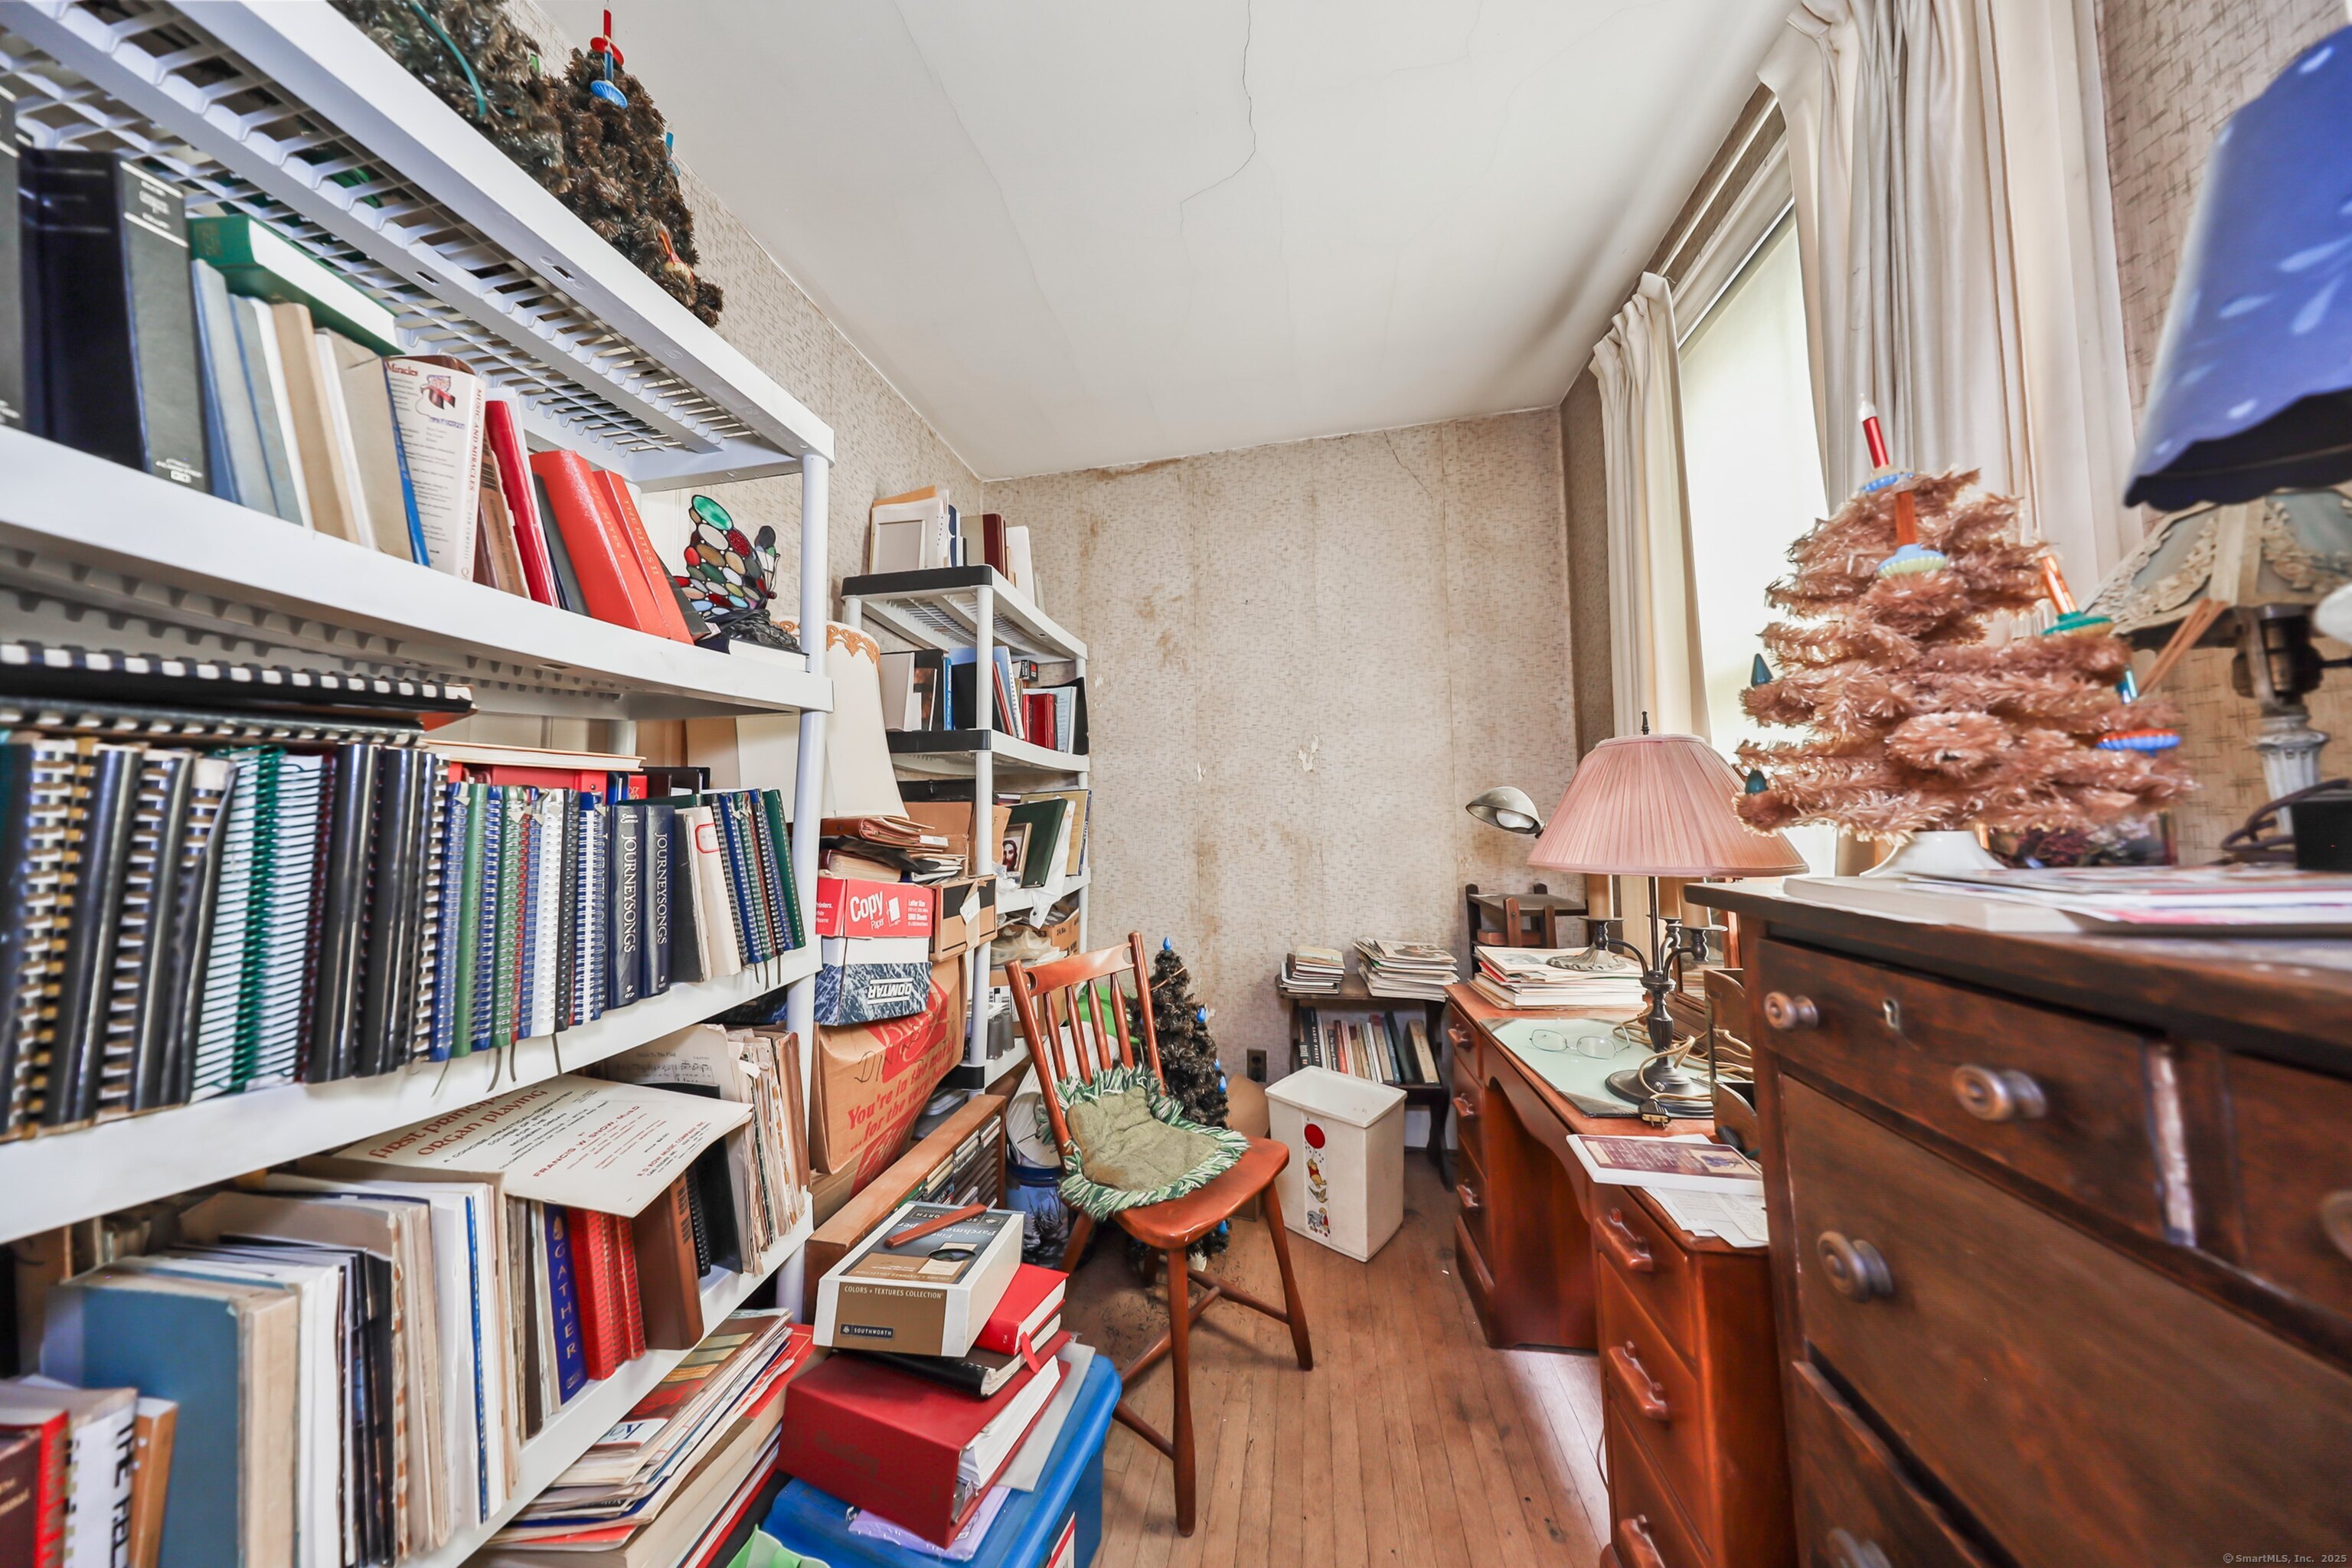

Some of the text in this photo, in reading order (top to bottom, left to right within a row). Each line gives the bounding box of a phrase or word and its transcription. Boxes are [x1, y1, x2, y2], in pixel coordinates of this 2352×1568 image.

[474, 388, 483, 420] MUSIC
[472, 423, 482, 443] AND
[469, 445, 480, 492] MIRACLES
[601, 511, 622, 549] RITES
[622, 498, 637, 524] THE
[634, 527, 655, 564] RITES
[621, 834, 638, 954] JOURNEYSONGS
[655, 832, 668, 946] JOURNEYSONGS
[849, 890, 884, 923] Copy
[871, 917, 884, 931] Paper
[867, 983, 913, 999] DOMTAR
[848, 1094, 892, 1131] You're
[895, 1080, 907, 1098] in
[850, 1119, 883, 1153] ...for
[886, 1102, 905, 1123] the
[908, 1083, 929, 1108] very
[532, 1148, 577, 1177] FRANCIS
[946, 1226, 997, 1237] Parchme
[554, 1242, 577, 1360] GATHER
[844, 1285, 867, 1294] COLORS
[874, 1288, 904, 1297] TEXTURES
[854, 1327, 892, 1337] SOUTHWORTH
